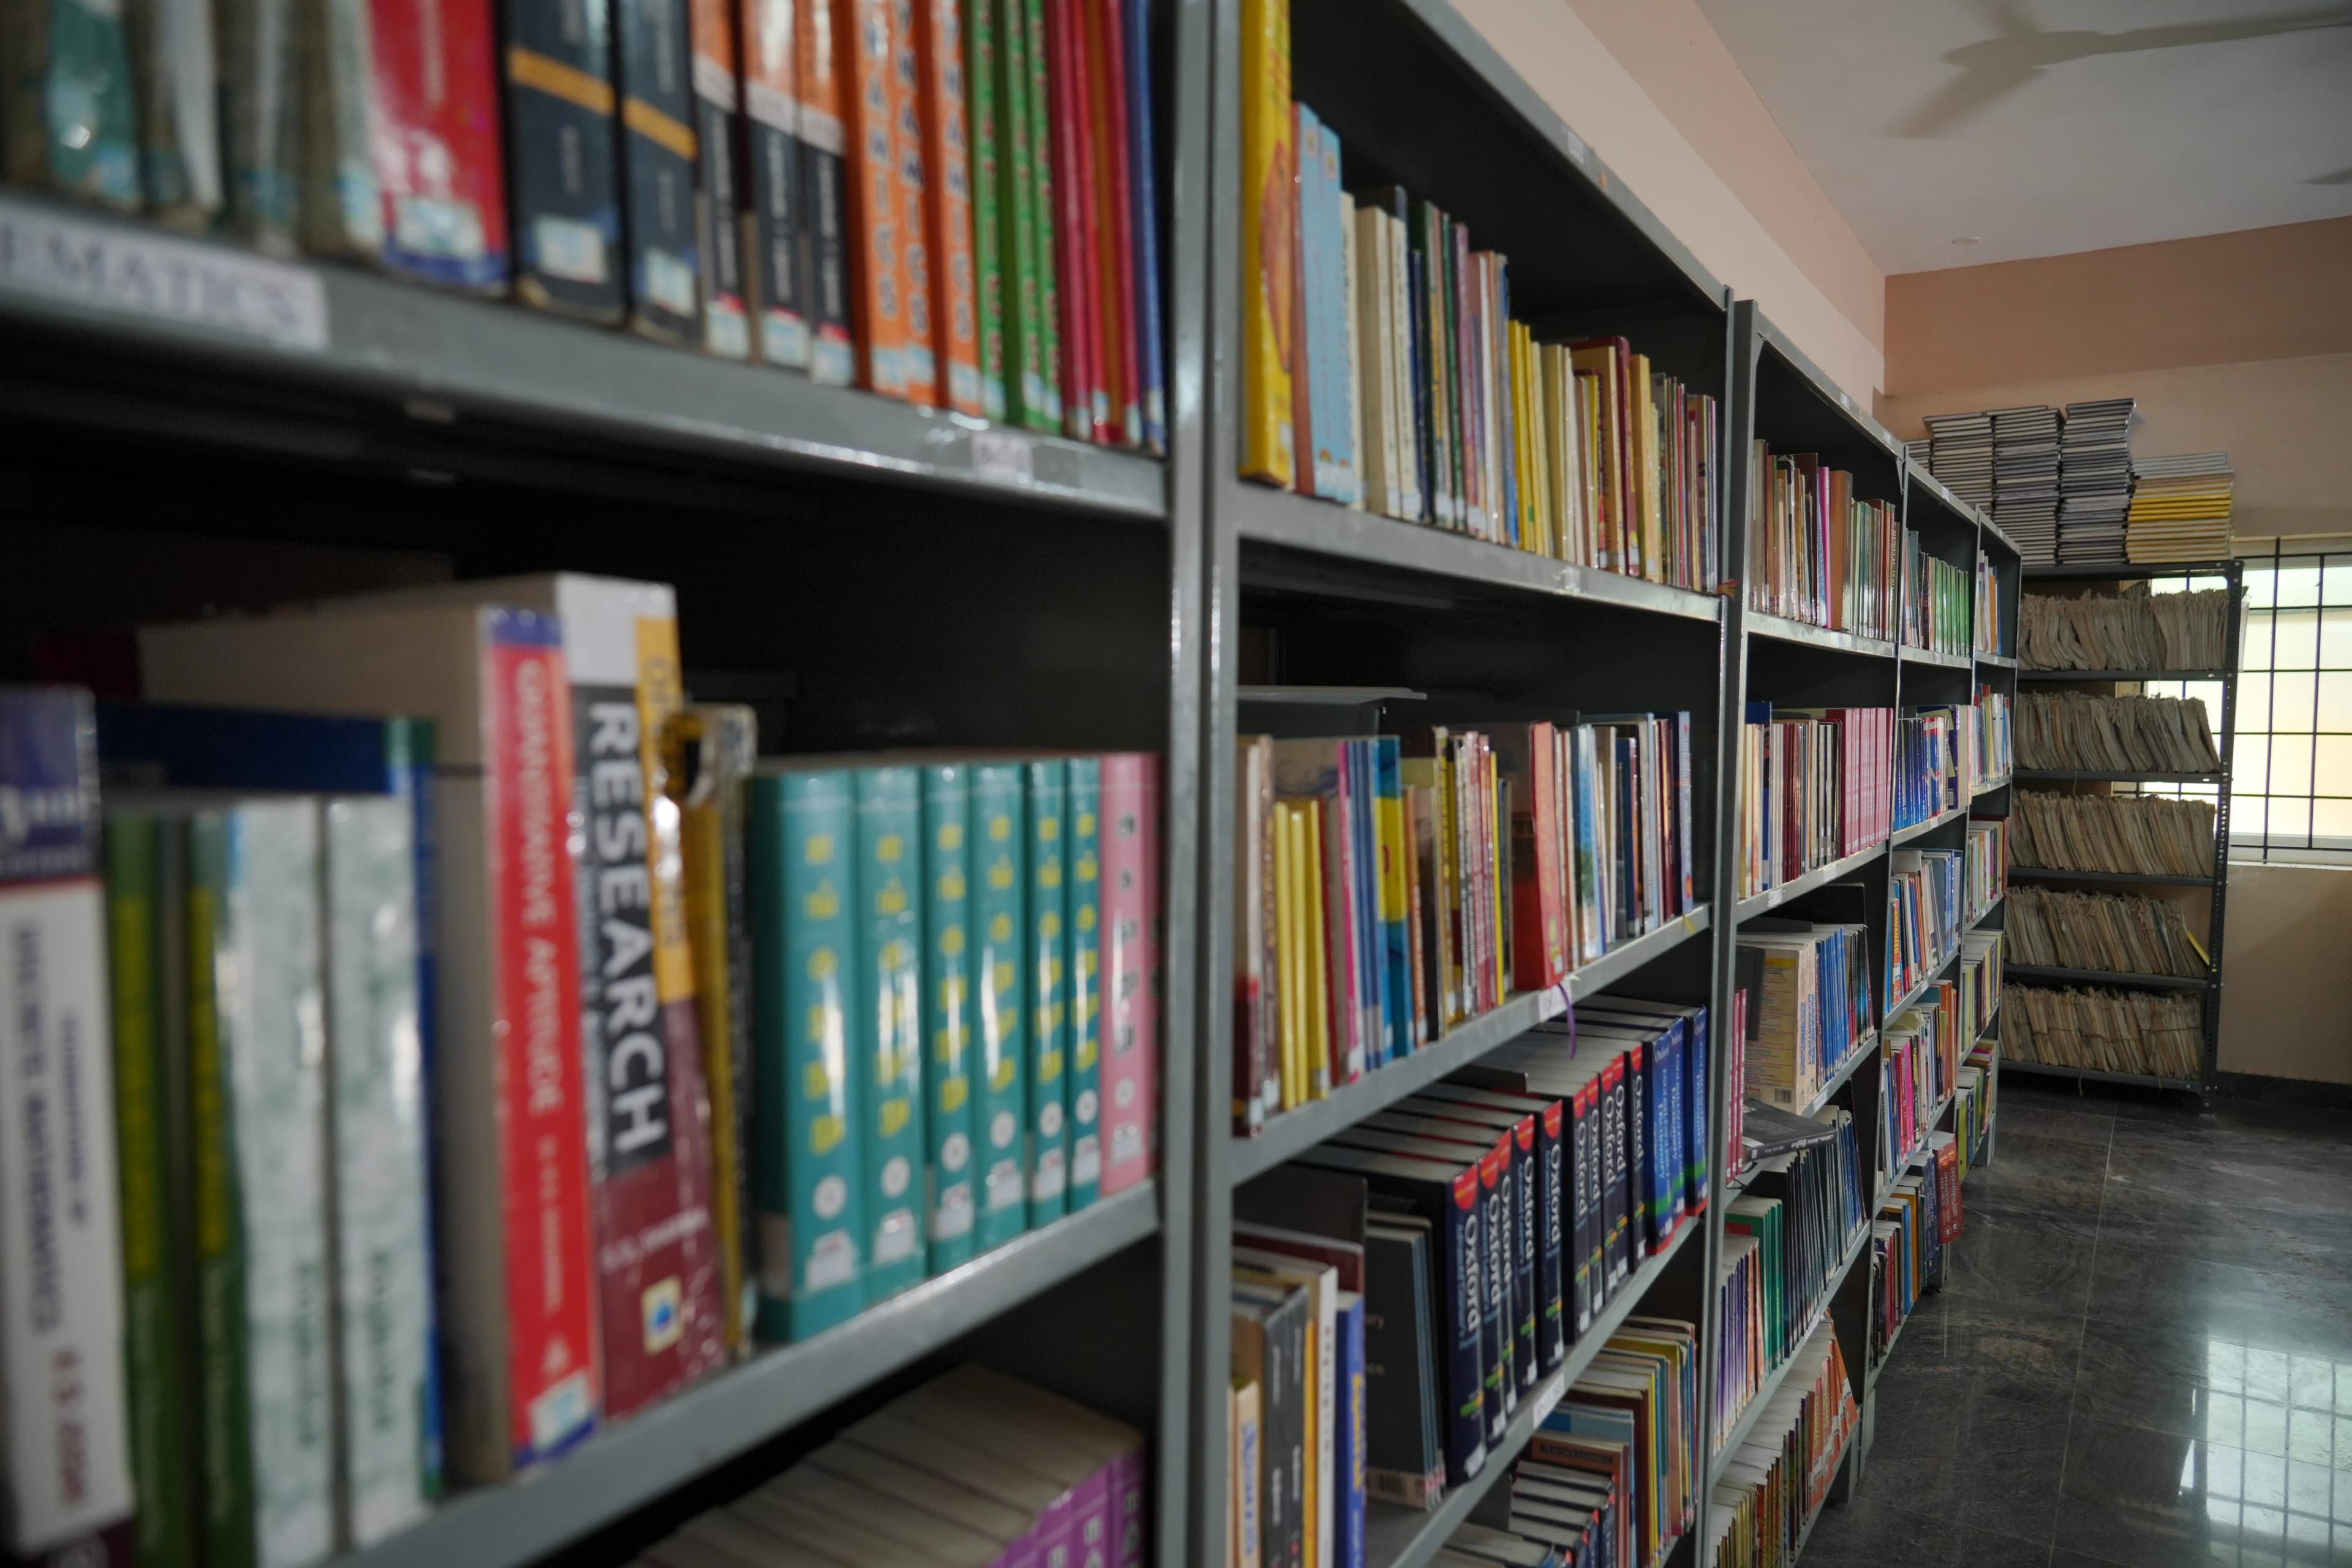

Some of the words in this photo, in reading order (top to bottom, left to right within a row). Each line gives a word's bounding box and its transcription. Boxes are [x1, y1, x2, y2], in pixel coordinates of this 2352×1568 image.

[588, 700, 669, 1154] RESEARCH
[1591, 1108, 1600, 1201] Oxford
[1605, 1095, 1616, 1185] Oxford
[1615, 1084, 1626, 1172] Oxford
[1634, 1074, 1645, 1162] Oxford
[1524, 1155, 1535, 1260] Oxford
[1550, 1144, 1562, 1245] Oxford
[1577, 1121, 1588, 1217] Oxford
[1464, 1214, 1482, 1333] Oxford
[1488, 1193, 1501, 1307] Oxford
[1501, 1174, 1512, 1284] Oxford
